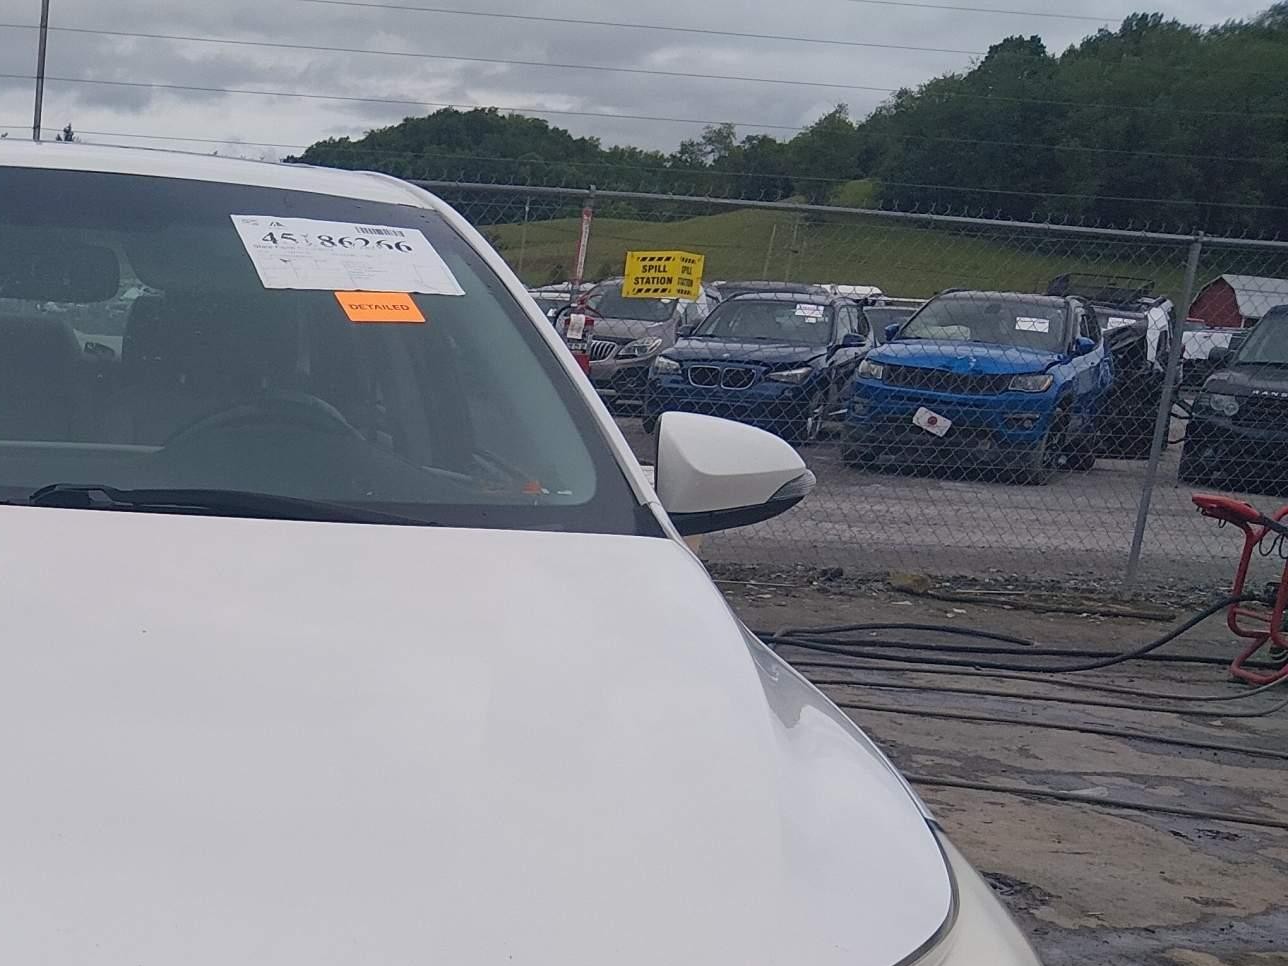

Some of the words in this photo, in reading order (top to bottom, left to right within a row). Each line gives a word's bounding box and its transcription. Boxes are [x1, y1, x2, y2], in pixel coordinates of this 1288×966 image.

[642, 264, 668, 274] SPILL
[633, 276, 673, 286] STATION
[348, 303, 410, 312] DETAILED
